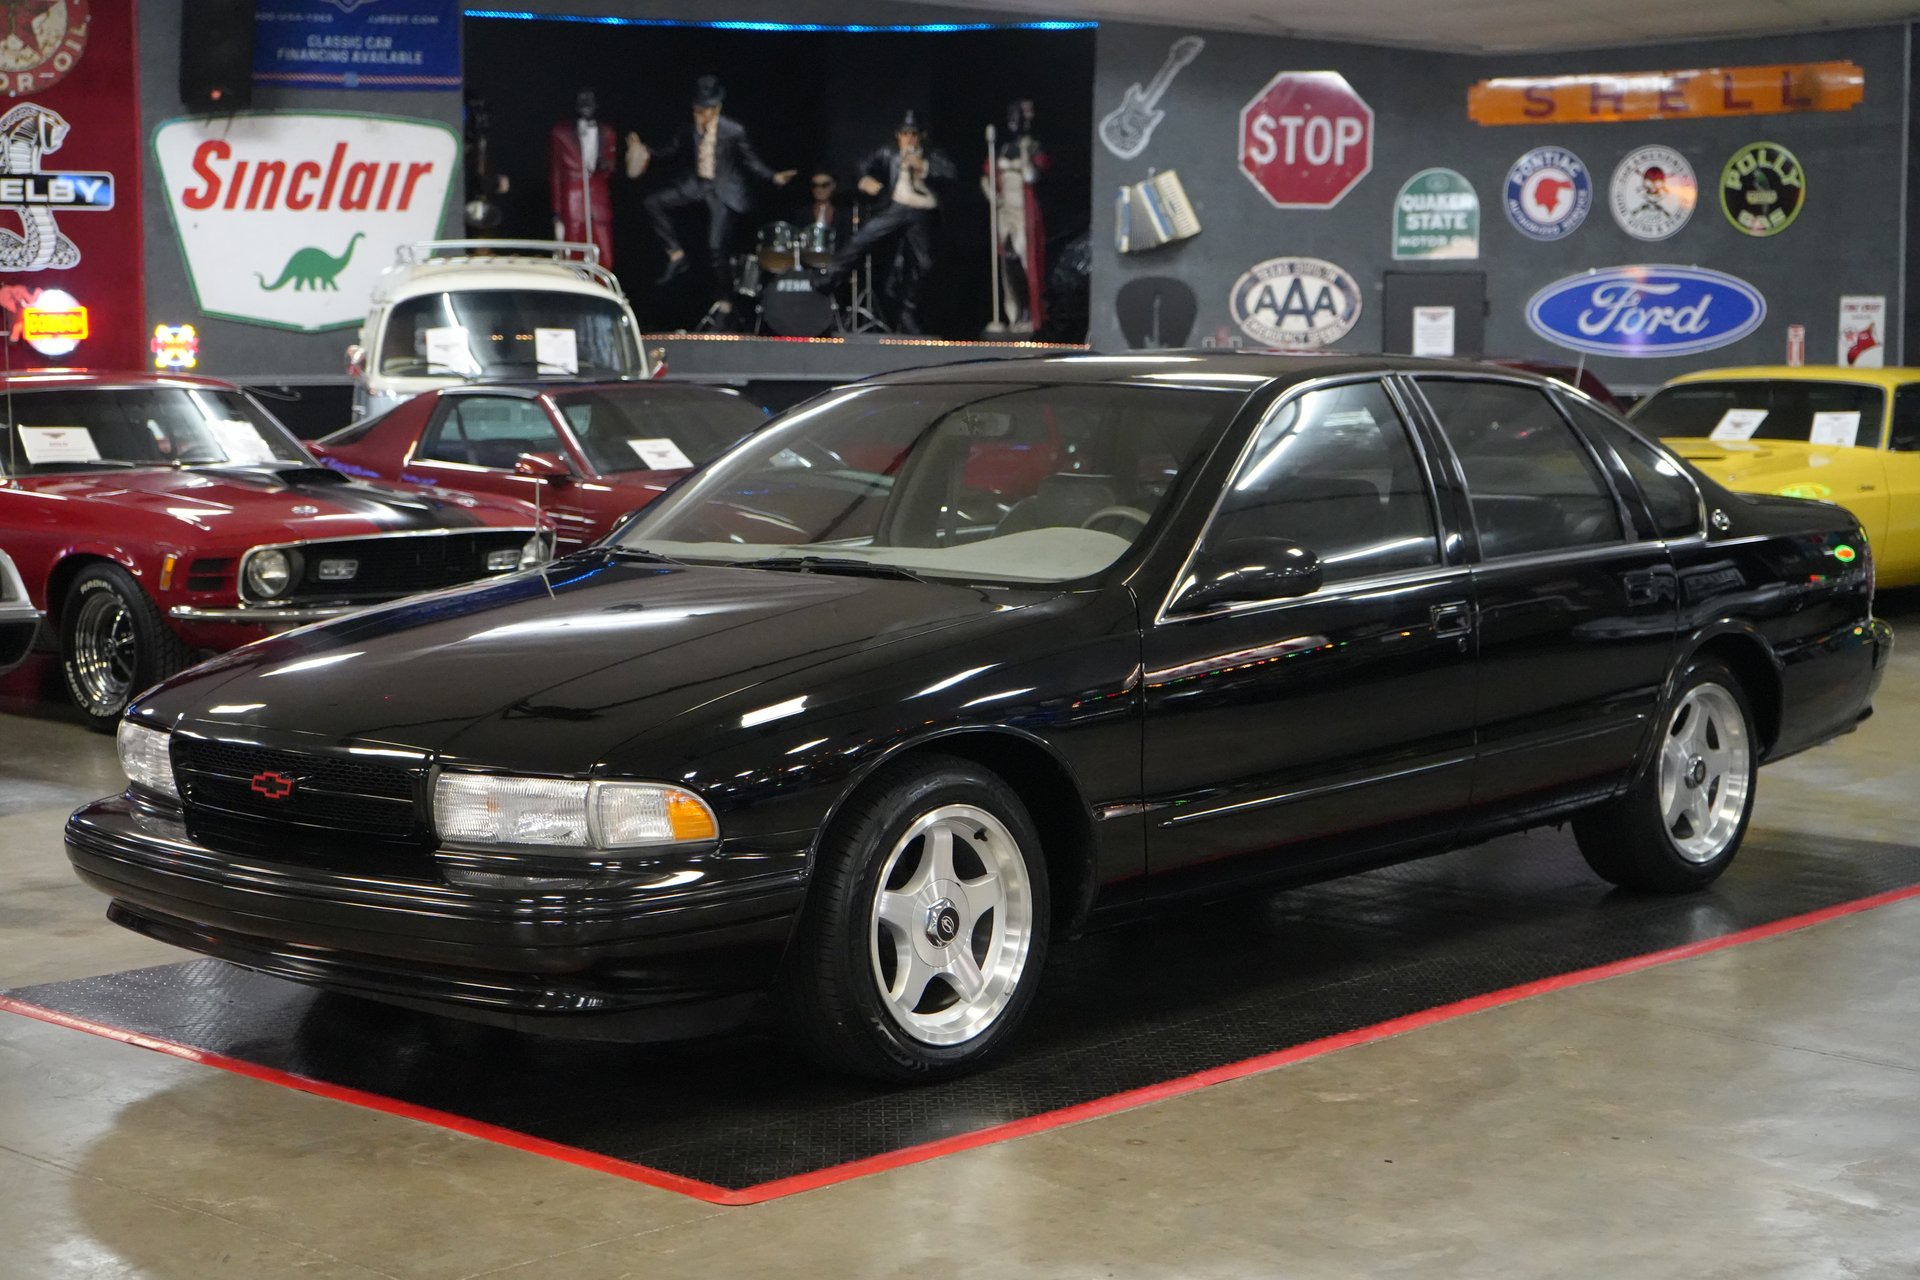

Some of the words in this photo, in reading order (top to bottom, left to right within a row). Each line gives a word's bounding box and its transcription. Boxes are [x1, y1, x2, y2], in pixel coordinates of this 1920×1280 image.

[277, 48, 349, 63] FINANCING
[351, 51, 424, 65] AVAILABLE
[307, 34, 363, 48] CLASSIC
[365, 36, 392, 49] CAR
[1523, 70, 1811, 117] SHELL
[1250, 116, 1363, 166] STOP
[182, 139, 434, 212] Sinclair
[1511, 152, 1581, 185] PONTIAC
[1726, 149, 1801, 190] POLLY
[1400, 193, 1475, 211] QUAKER
[1738, 207, 1786, 229] GAS
[1405, 212, 1468, 230] STATE
[1399, 235, 1448, 248] MOTOR
[1254, 277, 1337, 328] AAA
[1578, 280, 1712, 336] Ford
[80, 579, 114, 594] RADIAL
[66, 661, 89, 708] COBRA
